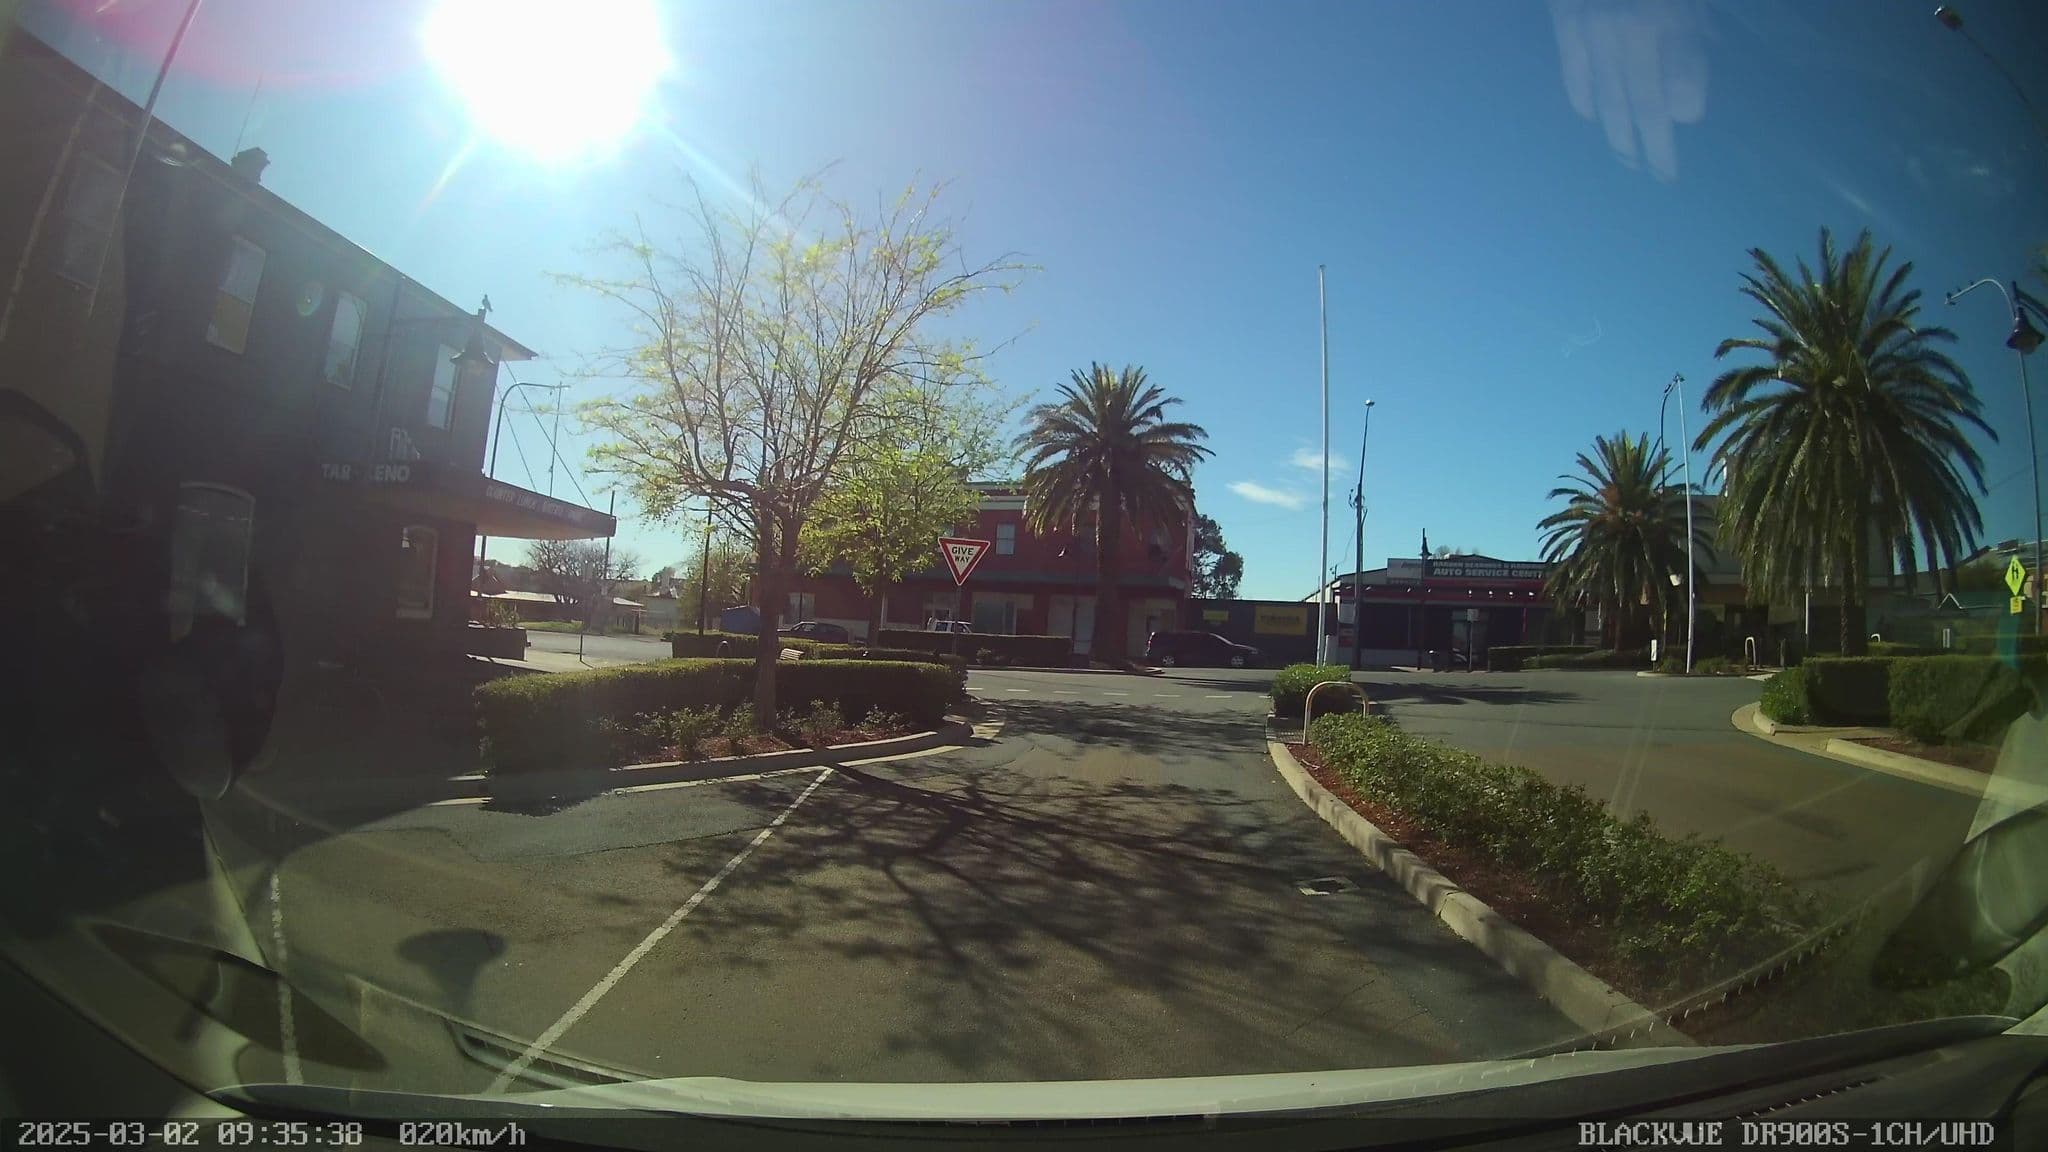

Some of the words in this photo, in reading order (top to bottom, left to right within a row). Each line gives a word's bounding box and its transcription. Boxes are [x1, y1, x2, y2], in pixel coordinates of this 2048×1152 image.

[951, 546, 974, 555] GIVE
[954, 555, 970, 563] WAY
[1433, 568, 1463, 577] AUTO
[1464, 568, 1509, 578] SERVICE
